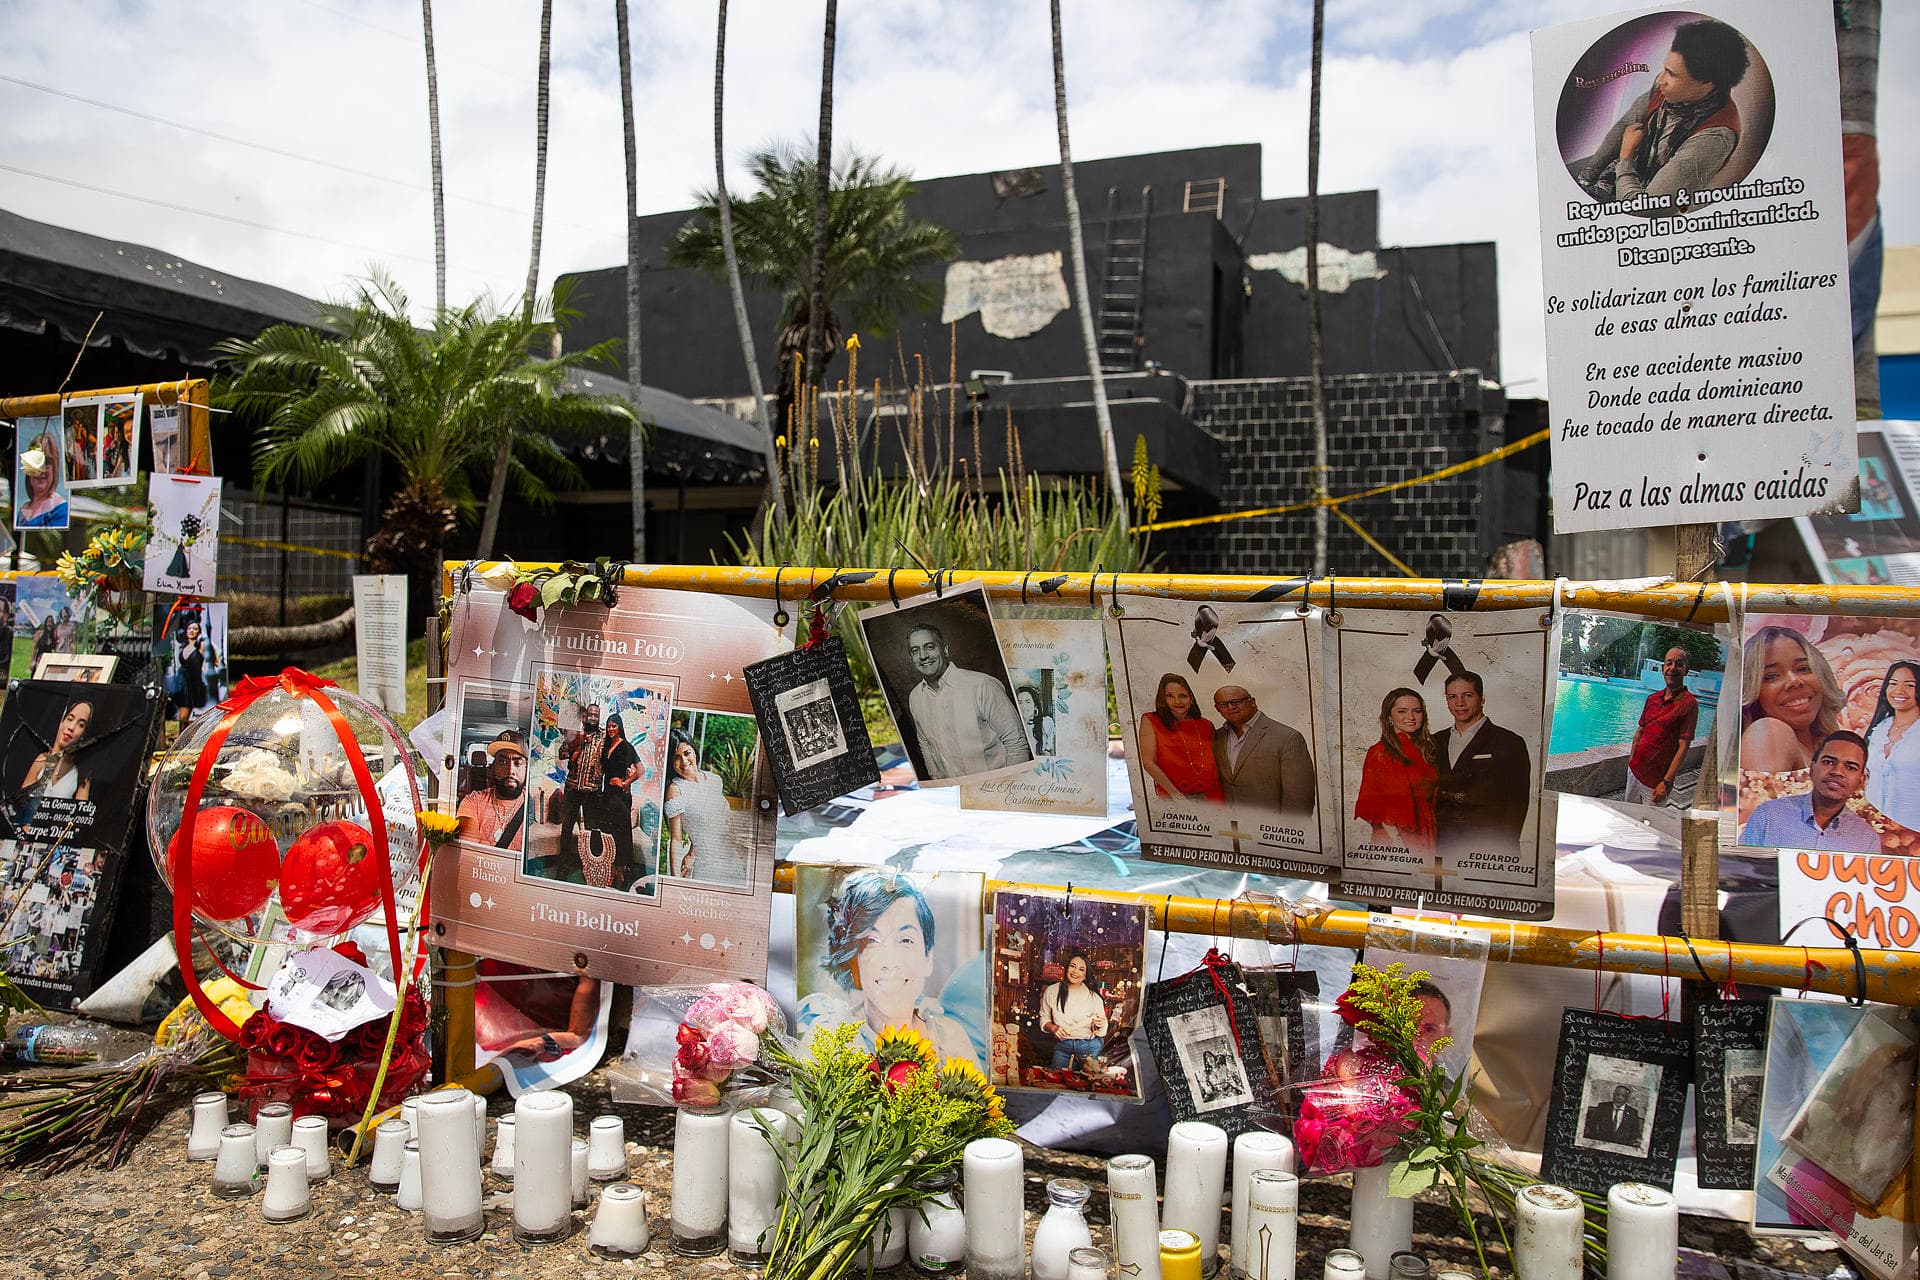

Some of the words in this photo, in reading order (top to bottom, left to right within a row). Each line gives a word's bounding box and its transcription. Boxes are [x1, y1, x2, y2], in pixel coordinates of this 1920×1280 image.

[1575, 76, 1597, 89] Rey
[1601, 60, 1649, 84] medina
[1567, 202, 1601, 220] Rey
[1605, 193, 1670, 216] medina
[1676, 189, 1690, 205] &
[1694, 177, 1804, 204] movimiento
[1557, 228, 1615, 247] unidos
[1616, 228, 1648, 244] por
[1650, 219, 1669, 237] la
[1672, 201, 1819, 234] Dominicanidad.
[1618, 247, 1669, 267] Dicen
[1672, 238, 1755, 264] presente.
[1547, 295, 1565, 315] Se
[1571, 287, 1666, 313] solidarizan
[1673, 287, 1705, 302] con
[1712, 278, 1736, 297] los
[1743, 270, 1838, 298] familiares
[1594, 317, 1614, 336] de
[1621, 317, 1658, 334] esas
[1664, 310, 1717, 330] almas
[1724, 302, 1788, 326] caídas.
[1586, 363, 1606, 381] En
[1613, 363, 1640, 379] ese
[1646, 353, 1731, 377] accidente
[1737, 347, 1803, 369] masivo
[1587, 386, 1641, 409] Donde
[1648, 382, 1691, 404] cada
[1697, 377, 1803, 401] dominicano
[1562, 418, 1589, 441] fue
[1596, 411, 1654, 436] tocado
[1660, 410, 1681, 431] de
[1687, 408, 1756, 430] manera
[1763, 403, 1833, 425] directa.
[1573, 482, 1612, 511] Paz
[1619, 489, 1633, 508] a
[1640, 476, 1671, 507] las
[1680, 472, 1746, 505] almas
[1754, 466, 1829, 500] caidas
[567, 632, 628, 654] ultima
[634, 638, 678, 660] Foto
[1046, 640, 1055, 650] de
[52, 799, 77, 815] Gómez
[1162, 812, 1198, 822] JOANNA
[1155, 821, 1167, 829] DE
[1169, 821, 1211, 832] GRULLÓN
[1259, 824, 1305, 837] EDUARDO
[1262, 833, 1305, 845] GRULLON
[1357, 844, 1410, 855] ALEXANDRA
[475, 856, 503, 873] Tony
[1164, 846, 1181, 858] HAN
[1182, 847, 1196, 859] IDO
[1198, 850, 1220, 863] PERO
[1221, 853, 1233, 863] NO
[1235, 854, 1250, 866] LOS
[1251, 856, 1281, 870] HEMOS
[1346, 852, 1387, 862] GRULLON
[1389, 855, 1424, 865] SEGURA
[1457, 860, 1505, 872] ESTRELLA
[1507, 865, 1536, 875] CRUZ
[1469, 852, 1520, 864] EDUARDO
[472, 867, 507, 885] Blanco
[1797, 852, 1920, 902] Jug
[1355, 885, 1375, 897] HAN
[1376, 887, 1393, 899] IDO
[1394, 889, 1418, 901] PERO
[1435, 893, 1452, 905] LOS
[1454, 895, 1487, 909] HEMOS
[530, 902, 570, 925] ¡Tan
[575, 911, 640, 938] Bellos!
[24, 977, 41, 987] todas
[42, 980, 53, 989] tus
[53, 983, 73, 992] metas
[1775, 1164, 1805, 1194] Malditos
[1858, 1233, 1874, 1249] del
[1870, 1243, 1885, 1260] Jet
[1883, 1253, 1899, 1270] Set
